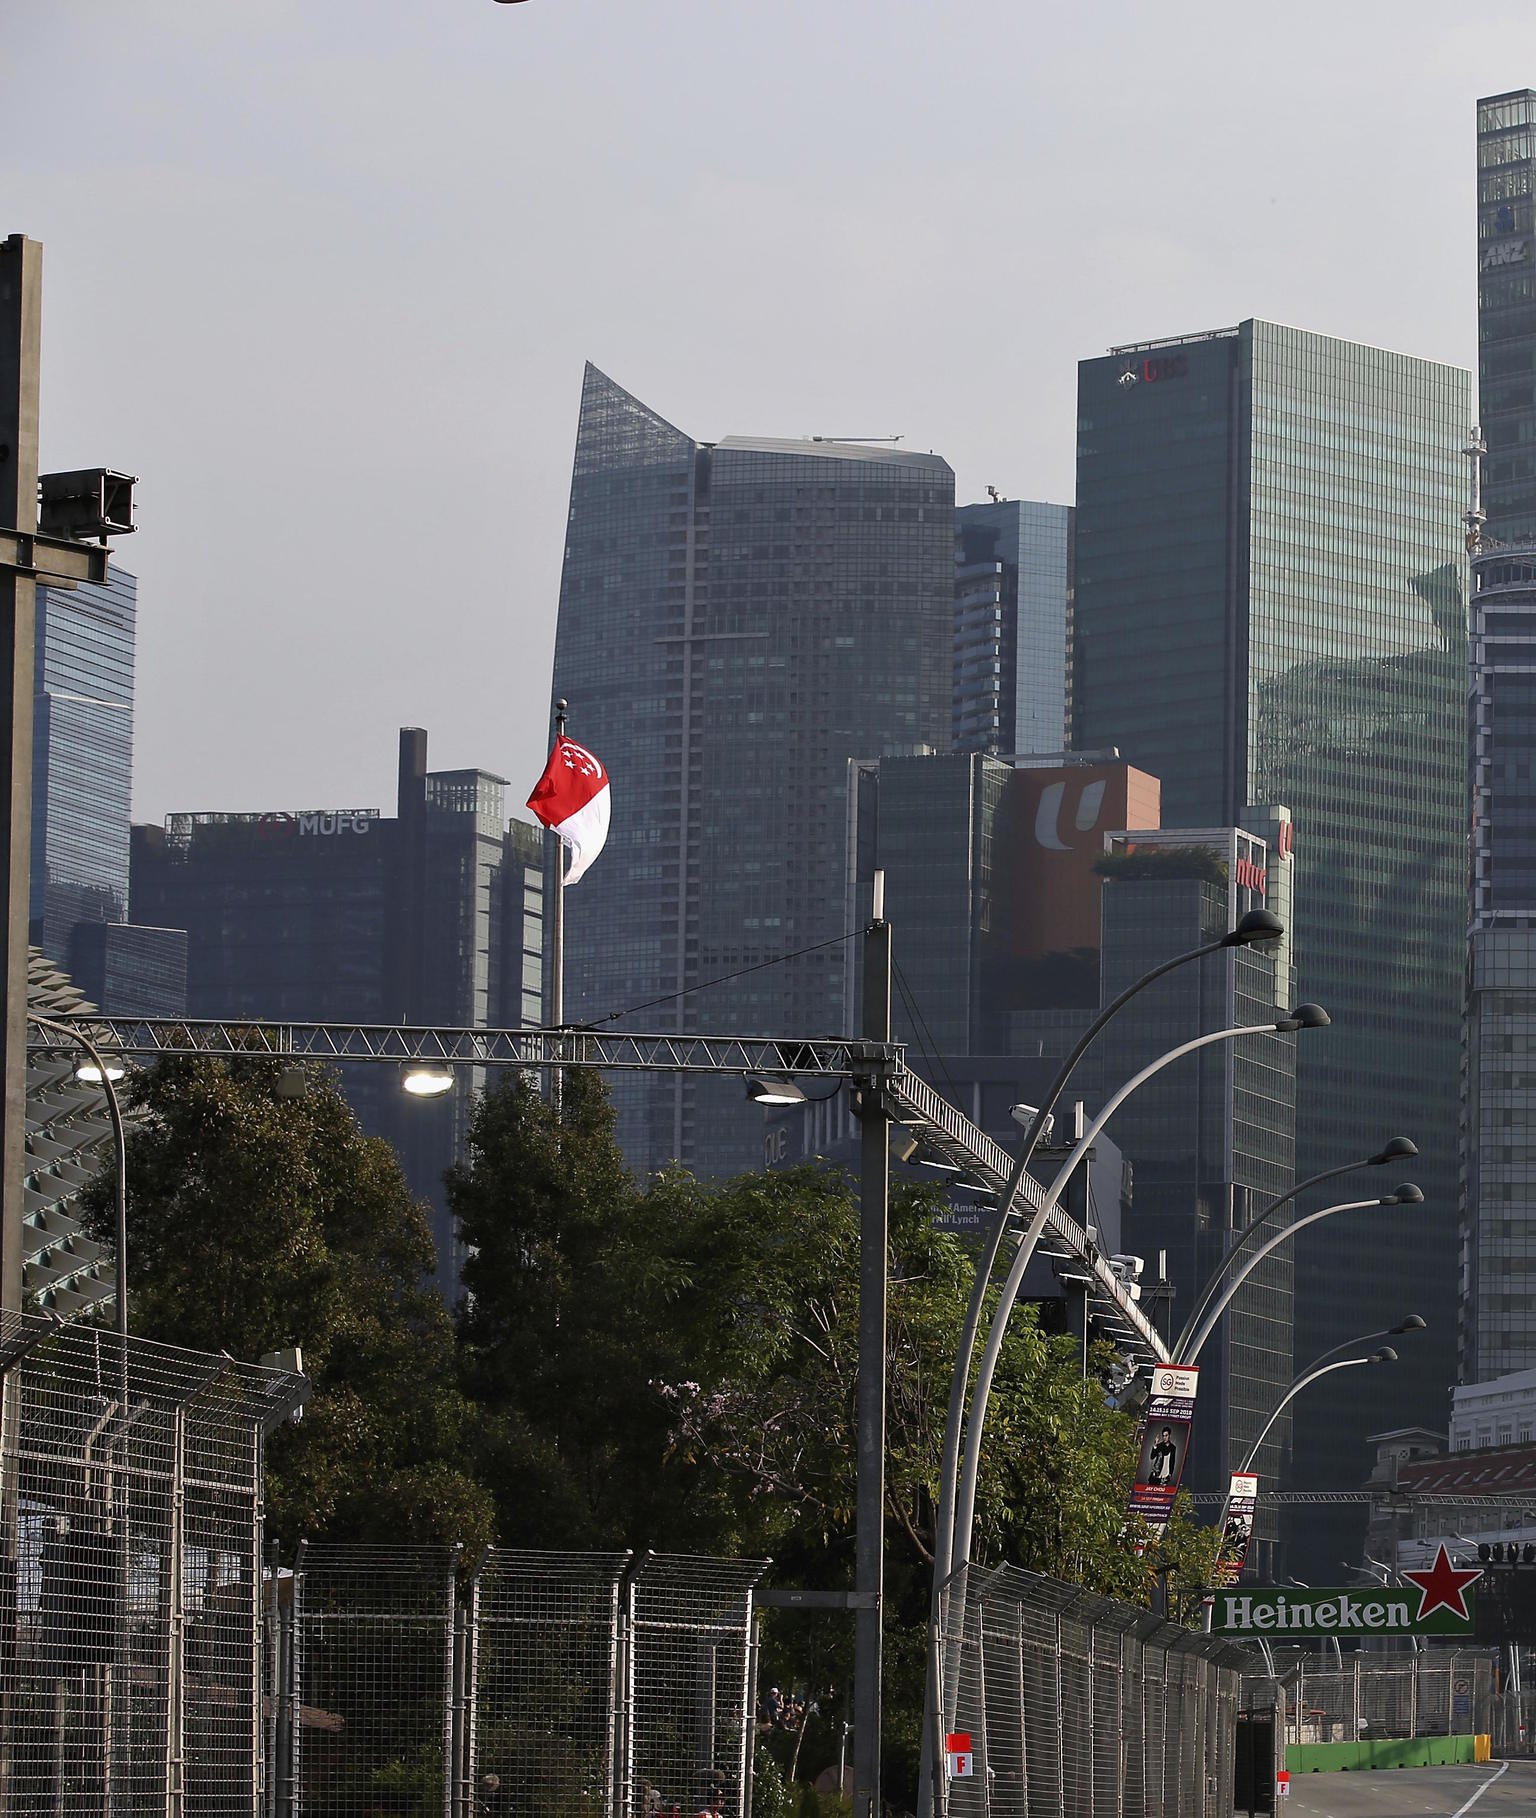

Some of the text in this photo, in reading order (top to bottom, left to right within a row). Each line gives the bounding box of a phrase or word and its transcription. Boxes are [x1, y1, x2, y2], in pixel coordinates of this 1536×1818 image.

[1482, 241, 1529, 269] ANZ
[299, 813, 369, 836] MUFG
[952, 1214, 980, 1225] Lynch
[1223, 1595, 1411, 1630] Heineken
[957, 1756, 966, 1774] F
